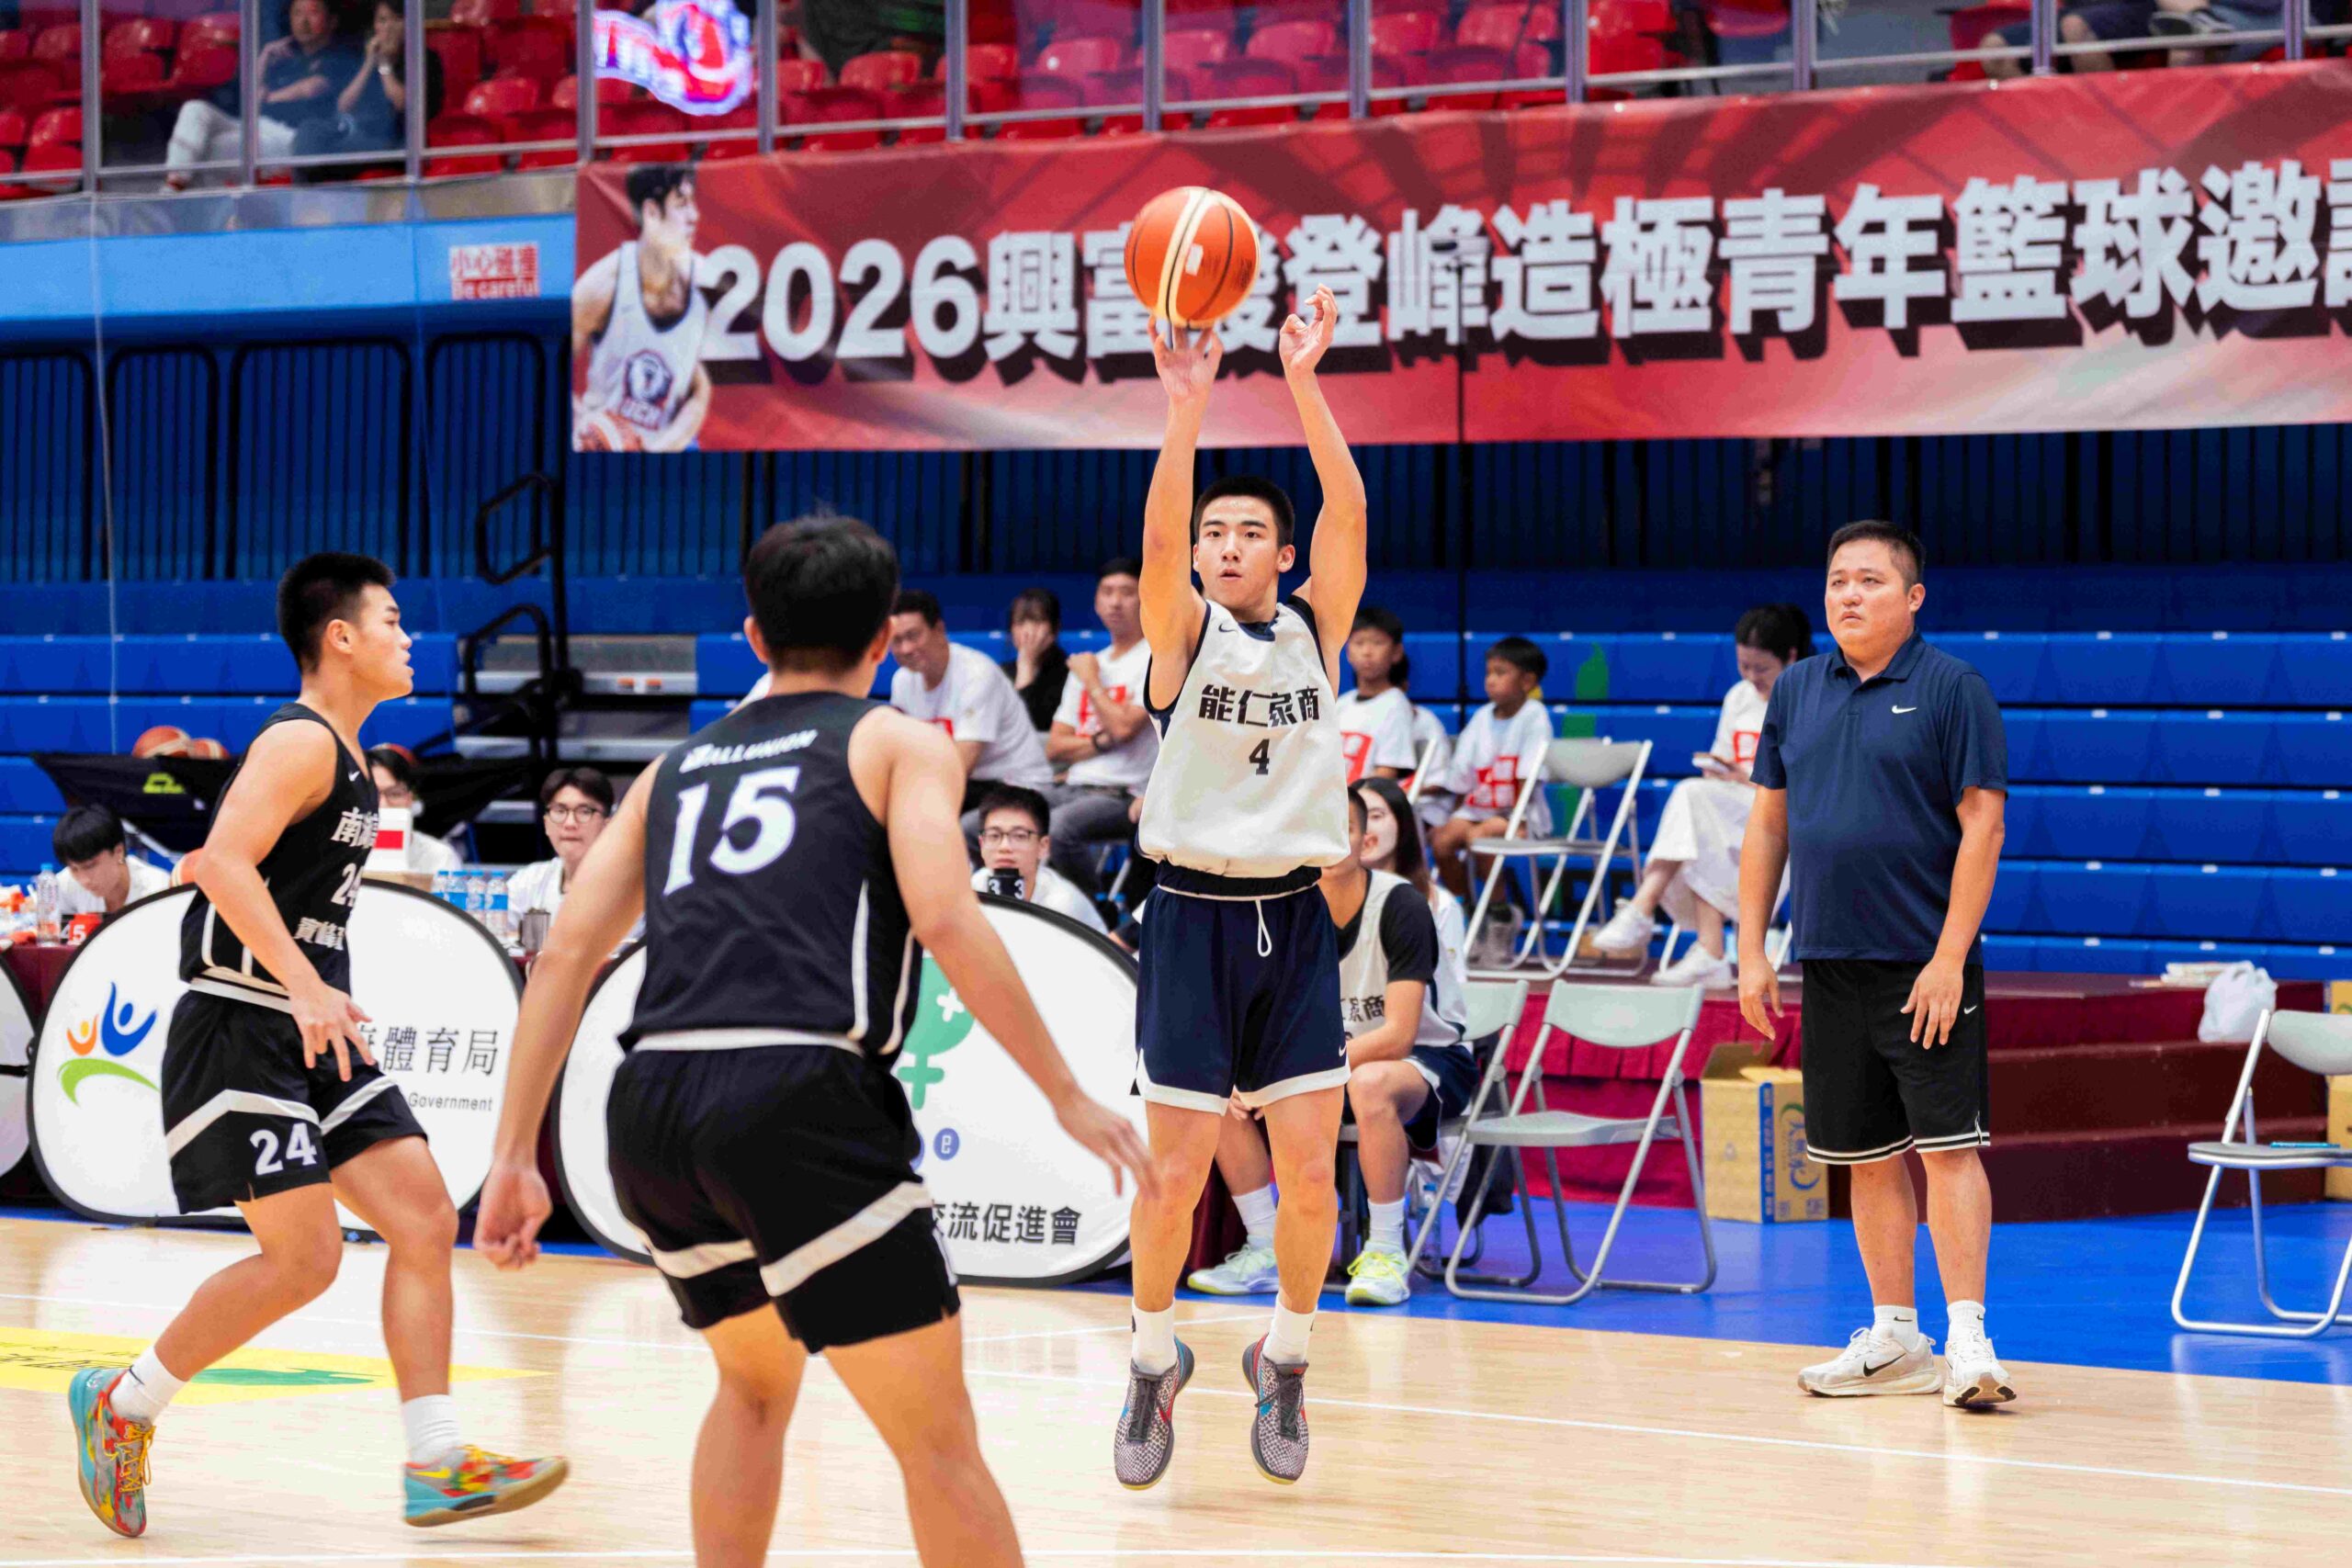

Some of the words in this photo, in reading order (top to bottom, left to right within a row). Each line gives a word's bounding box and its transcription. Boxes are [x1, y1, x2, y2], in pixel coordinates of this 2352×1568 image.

[695, 158, 2352, 361] 2026興富登峰造極青年籃球邀
[1198, 683, 1320, 728] 能仁家商
[1249, 739, 1270, 775] 4
[662, 764, 802, 897] 15
[68, 924, 86, 945] 5
[1340, 995, 1385, 1021] 家商
[409, 1092, 493, 1111] Government
[249, 1122, 317, 1176] 24
